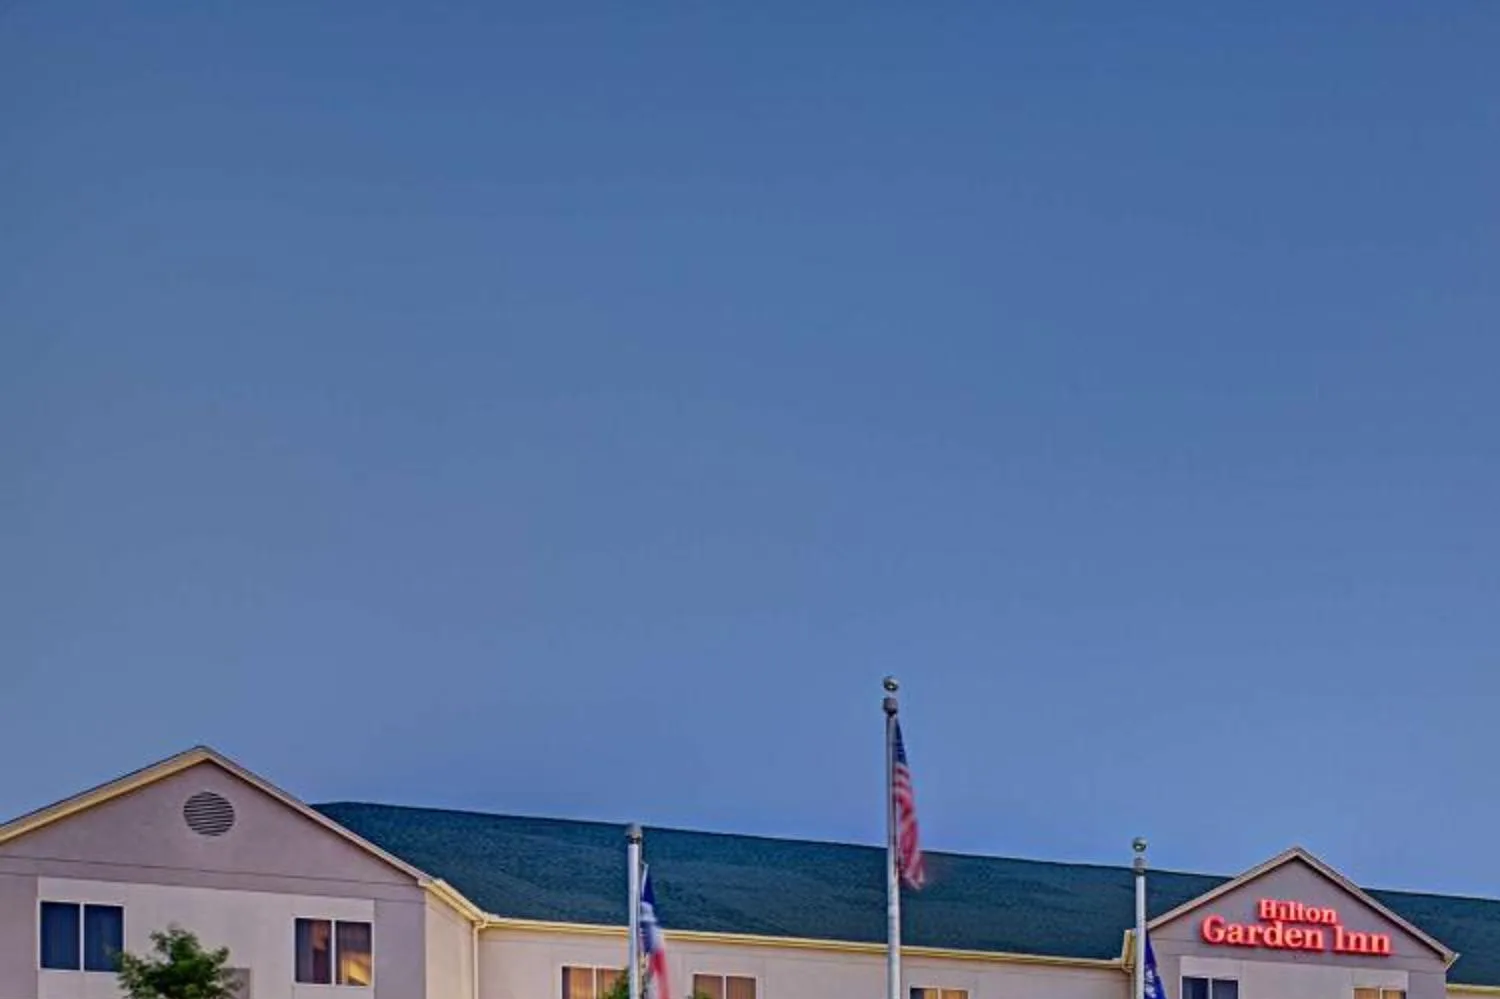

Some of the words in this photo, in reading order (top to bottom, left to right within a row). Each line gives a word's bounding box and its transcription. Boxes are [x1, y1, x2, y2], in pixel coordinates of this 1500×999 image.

[1259, 899, 1337, 924] Hilton
[1202, 915, 1323, 950] Garden
[1333, 925, 1391, 955] Inn
